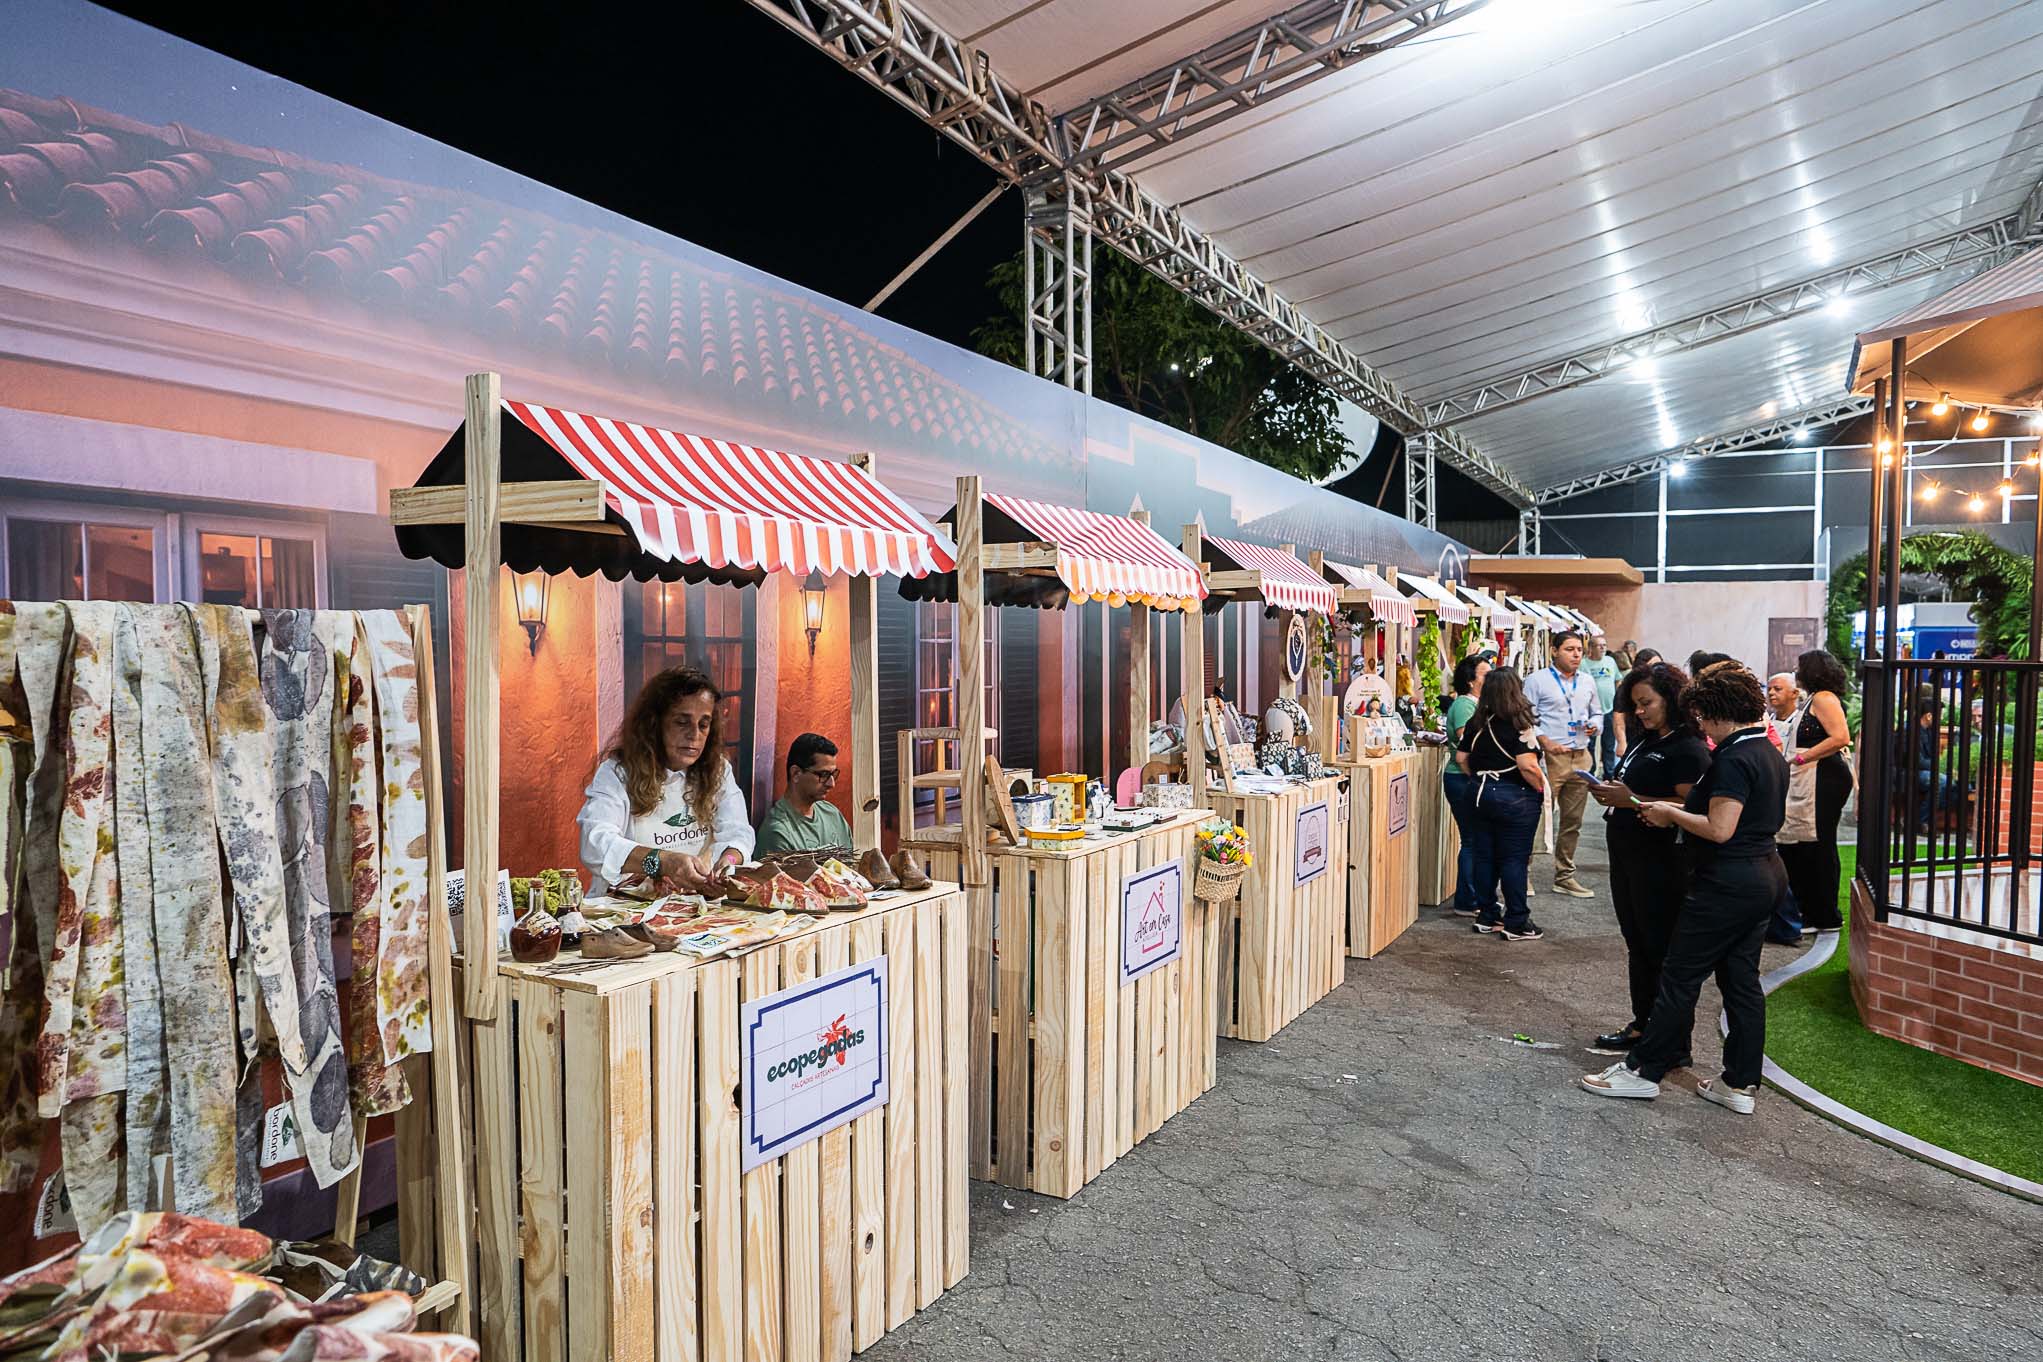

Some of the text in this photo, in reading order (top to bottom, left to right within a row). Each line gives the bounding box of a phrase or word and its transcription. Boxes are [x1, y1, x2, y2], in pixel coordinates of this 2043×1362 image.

[654, 827, 708, 845] bordone
[767, 1028, 865, 1082] ecopegadas
[270, 1107, 283, 1161] bordone
